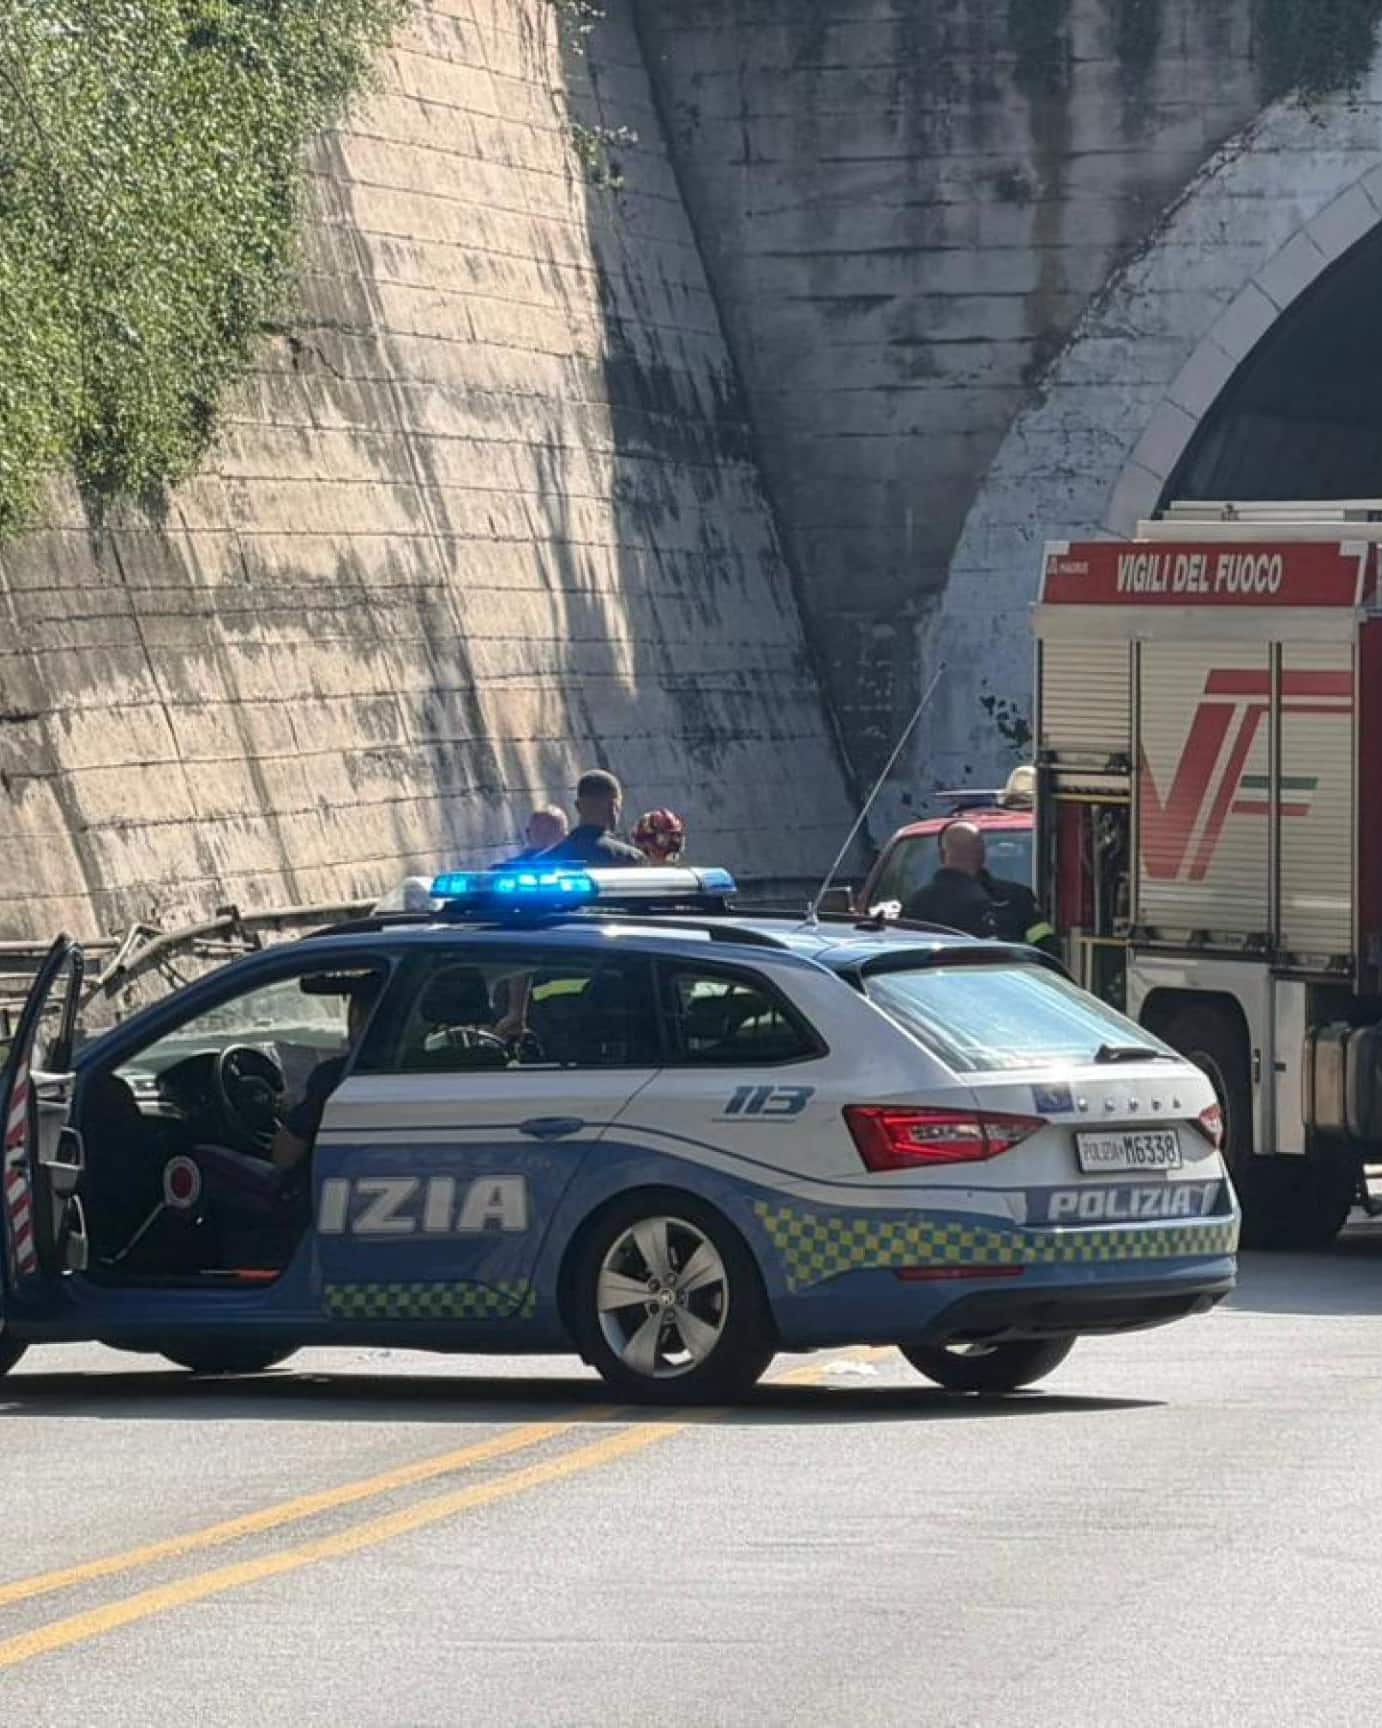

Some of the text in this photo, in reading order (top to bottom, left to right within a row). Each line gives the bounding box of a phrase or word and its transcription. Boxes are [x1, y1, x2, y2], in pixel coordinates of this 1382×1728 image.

[1116, 553, 1284, 594] VIGILI DEL FUOCO
[724, 1085, 816, 1115] 113
[1123, 1134, 1176, 1165] M6338
[1048, 1183, 1191, 1221] POLIZIA
